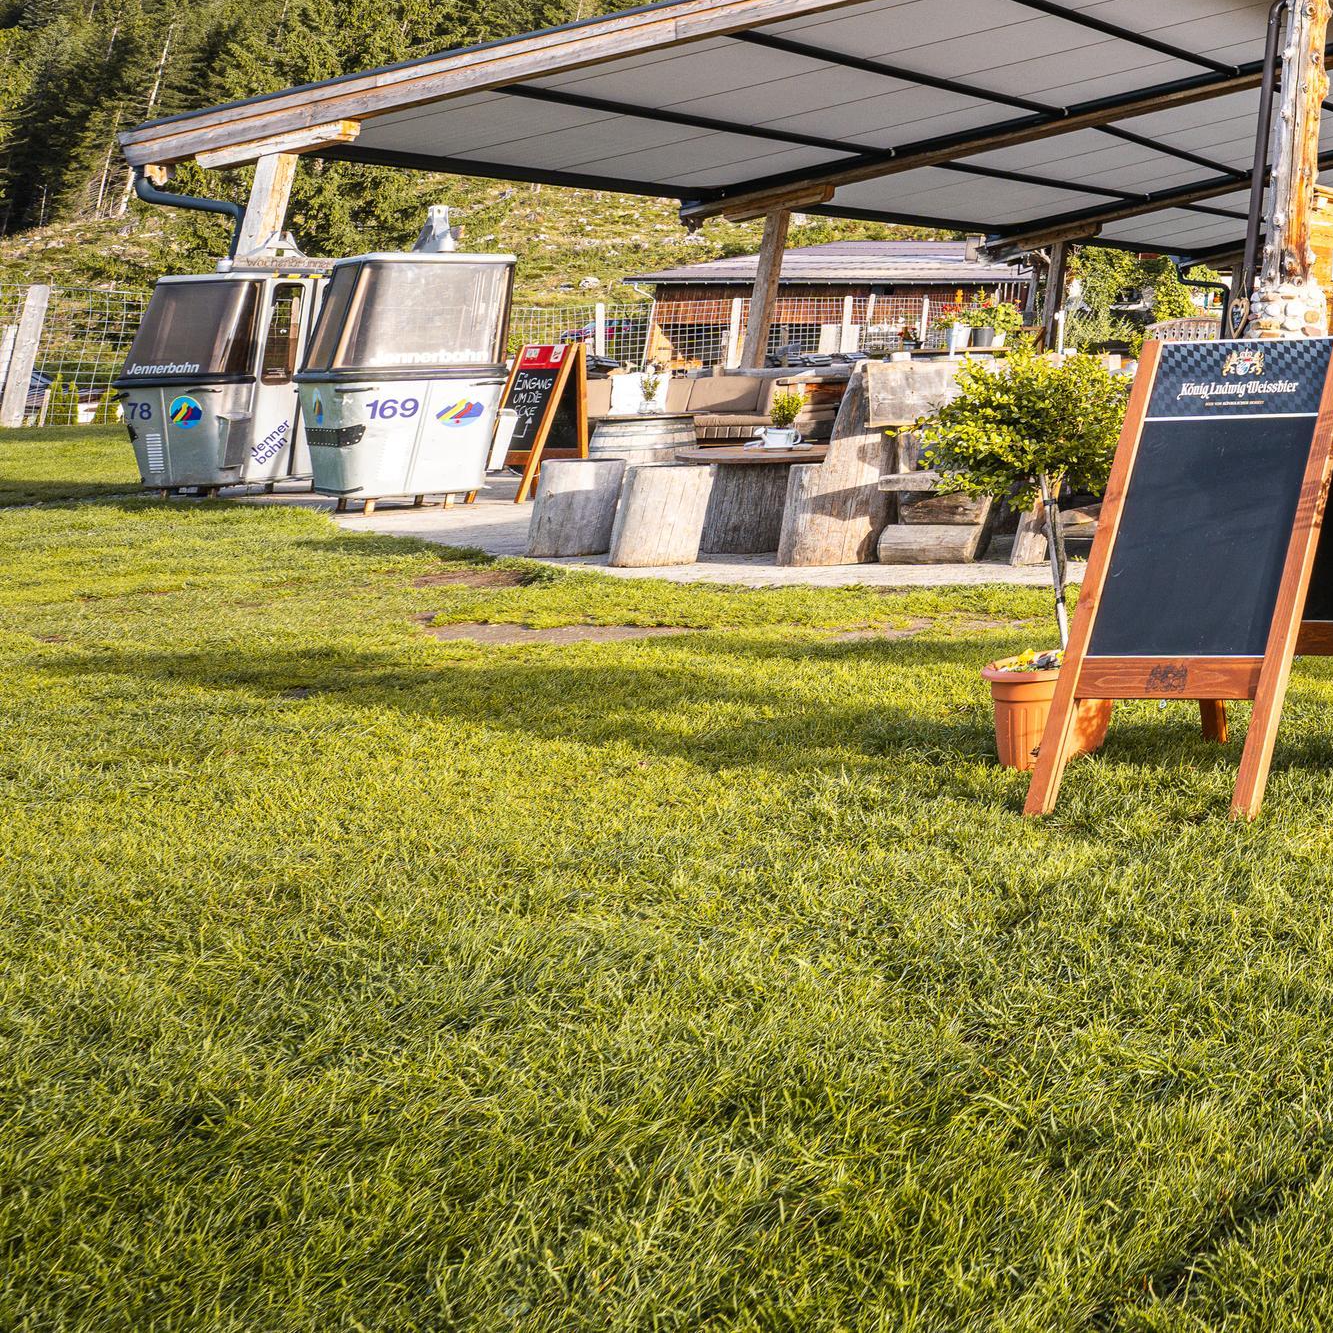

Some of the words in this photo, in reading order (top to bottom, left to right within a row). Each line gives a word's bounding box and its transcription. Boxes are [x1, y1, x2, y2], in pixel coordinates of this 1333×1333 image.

[126, 361, 200, 375] Jennerbahn
[1177, 381, 1209, 400] König
[1205, 381, 1247, 397] Ludwig
[1246, 380, 1299, 394] Weissbier
[366, 398, 420, 420] 169
[251, 420, 290, 457] Jenner
[255, 437, 288, 465] bahn
